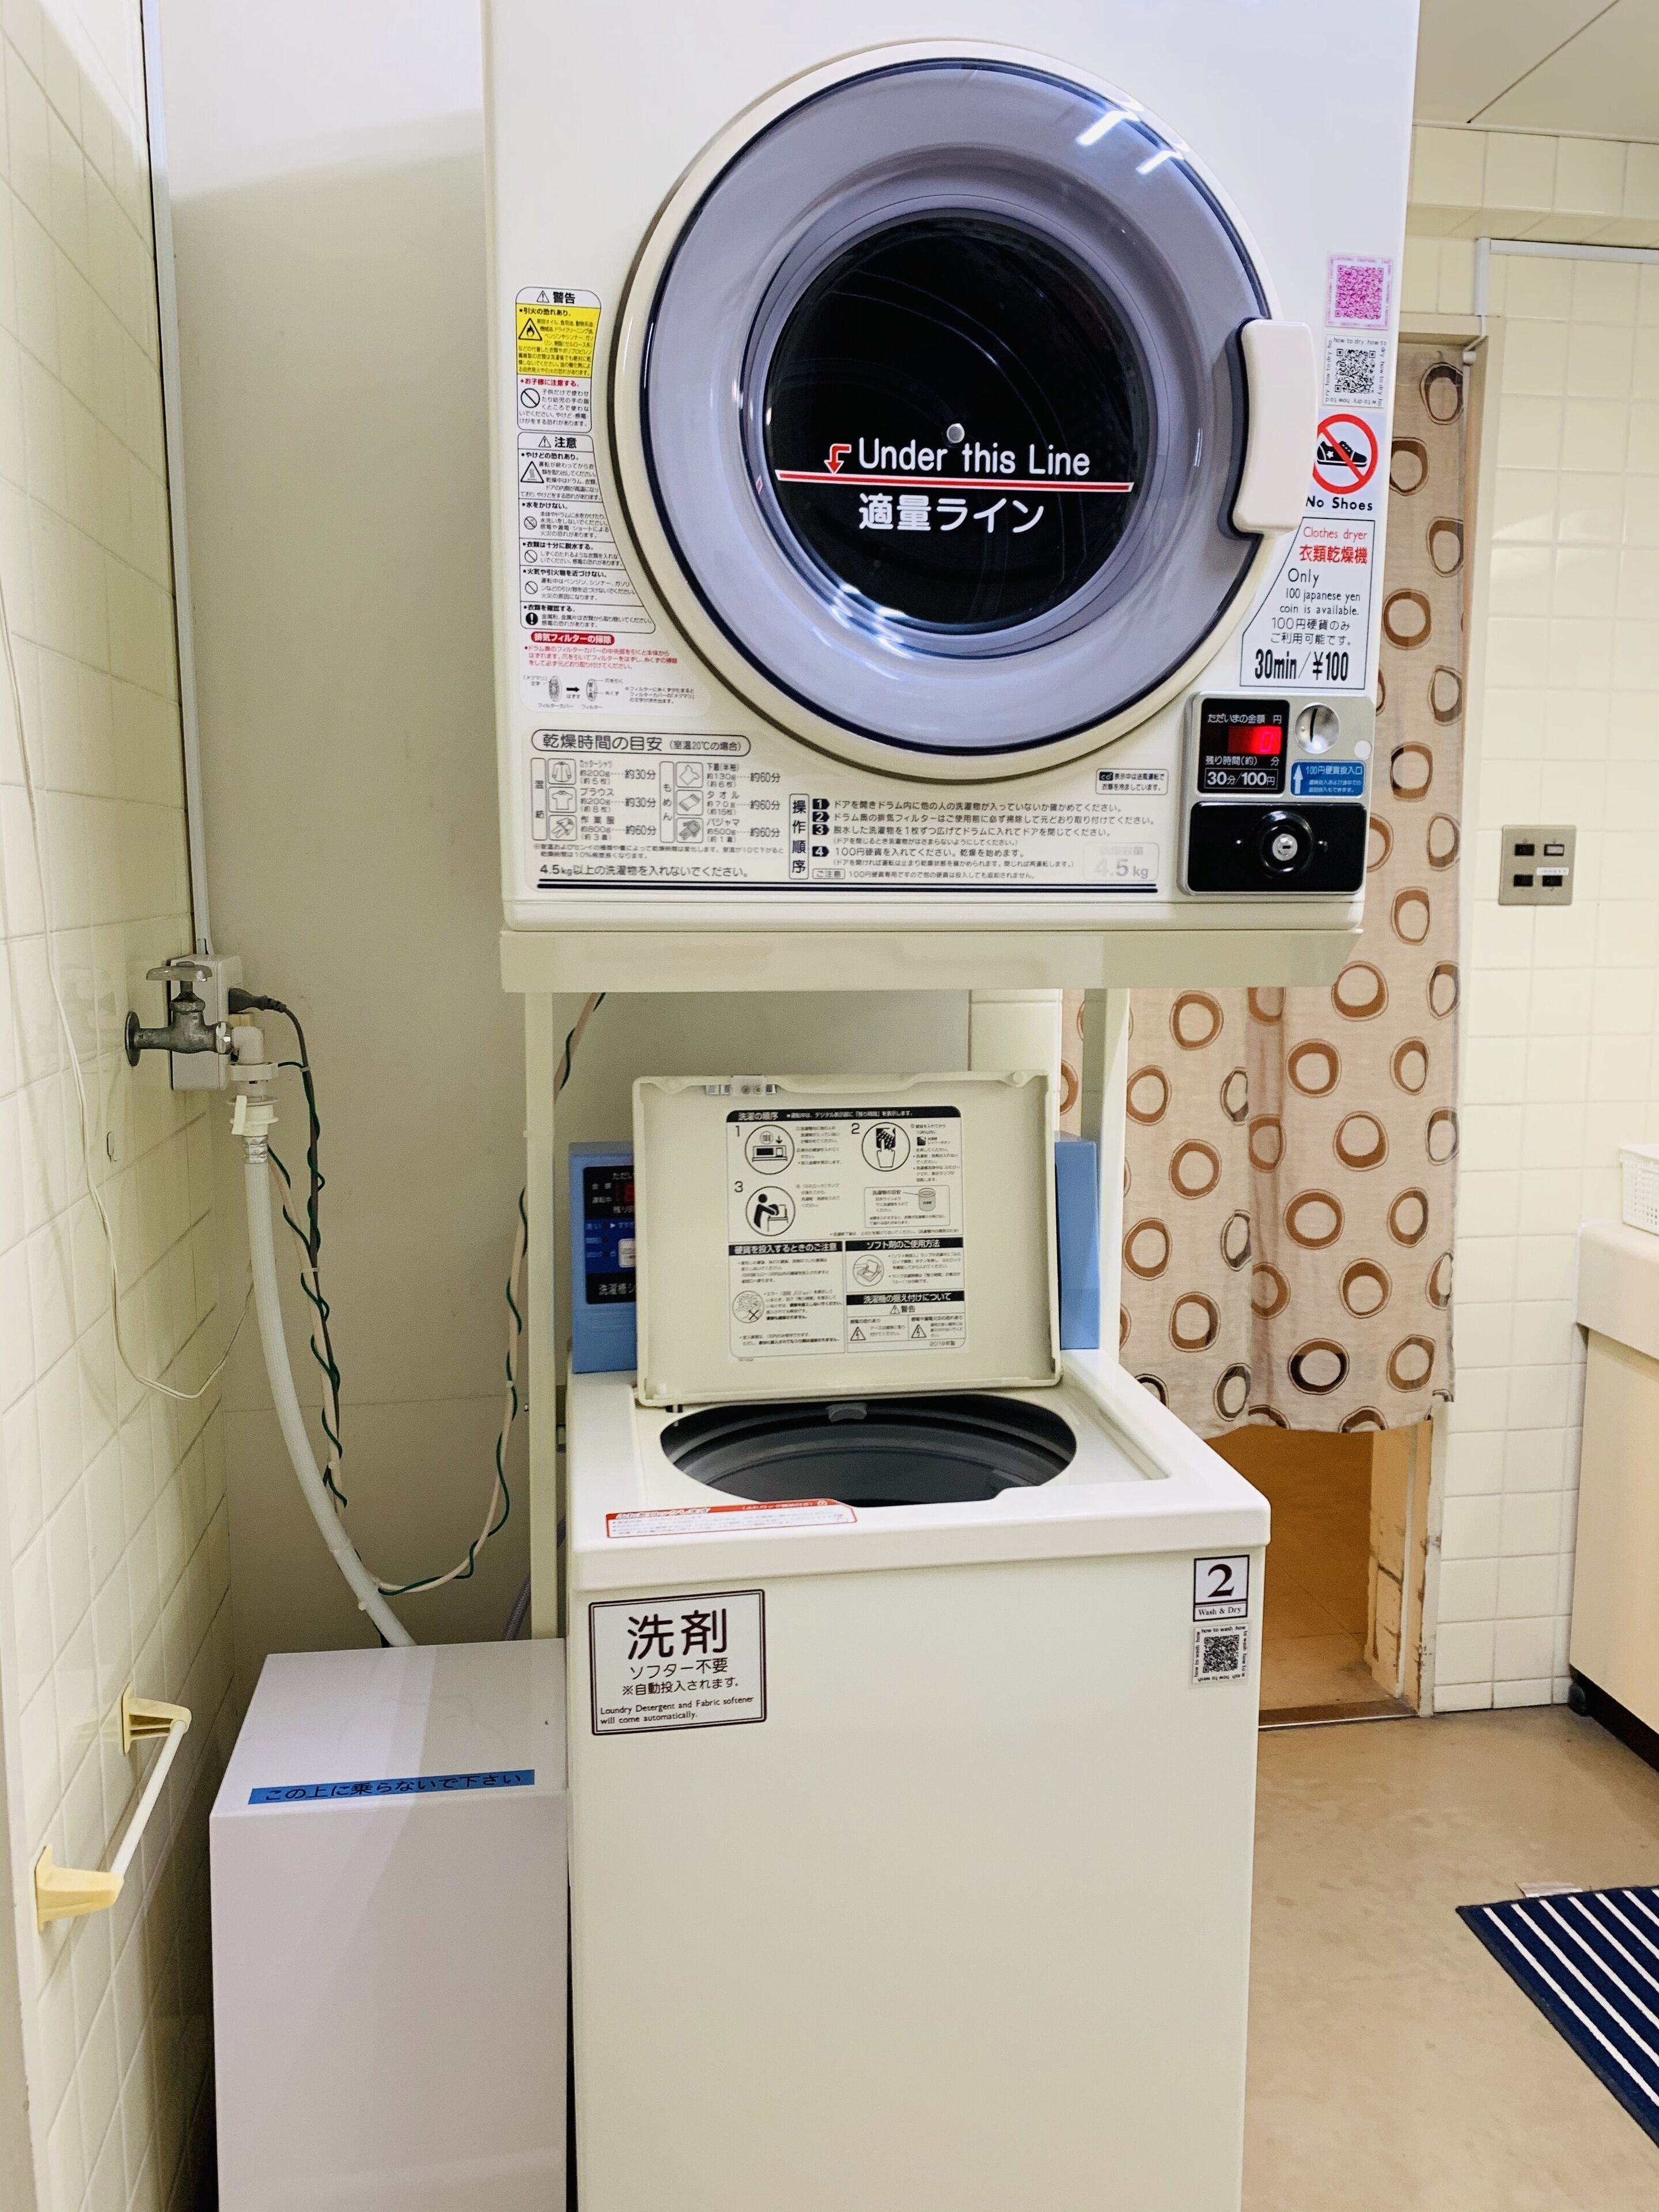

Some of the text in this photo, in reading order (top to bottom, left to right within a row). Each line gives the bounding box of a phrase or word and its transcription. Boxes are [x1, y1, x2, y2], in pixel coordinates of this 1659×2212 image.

[553, 291, 575, 304] 警告
[524, 308, 571, 317] 引火の恐れあり。
[525, 378, 579, 387] お子様に注意する。
[555, 436, 577, 449] 注意
[525, 452, 579, 461] やけどの恐れあり。
[858, 437, 1090, 476] Under this Line
[526, 502, 569, 510] 水をかけない。
[1305, 495, 1373, 511] No Shoes
[858, 493, 1045, 533] 適量ライン
[1303, 527, 1368, 543] Clothes dryer
[527, 541, 594, 550] 衣類は十分に脱水する。
[1300, 544, 1368, 565] 衣類乾燥機
[1288, 567, 1320, 589] Only
[1286, 588, 1361, 604] 100 japanese yen
[528, 604, 575, 613] 衣類を確認する。
[1279, 604, 1359, 616] coin is available.
[1271, 617, 1351, 631] 100円硬貨のみ
[534, 632, 612, 645] 排気フィルターの掃除
[1271, 632, 1351, 646] ご利用可能です。
[1207, 714, 1282, 724] ただいまの金額 円
[543, 733, 662, 751] 乾燥時間の目安
[1259, 731, 1274, 753] 0
[1205, 756, 1280, 766] 残り時間(約) 分
[625, 770, 656, 781] 約30分
[1305, 765, 1363, 775] 100円硬貨投入口
[750, 772, 781, 783] 約60分
[1207, 771, 1276, 786] 30分/100円
[580, 788, 615, 797] ブラウス
[707, 791, 740, 800] タオル
[625, 798, 656, 808] 約30分
[662, 783, 673, 821] もめん
[750, 800, 781, 810] 約60分
[816, 799, 823, 809] 1
[816, 812, 824, 822] 2
[625, 825, 656, 836] 約60分
[750, 827, 781, 838] 約60分
[816, 825, 824, 835] 3
[815, 846, 824, 856] 4
[540, 864, 749, 878] 4.5kg以上の洗濯物を入れないでください。
[1132, 865, 1149, 879] kg
[735, 1125, 740, 1137] 1
[851, 1123, 860, 1135] 2
[734, 1180, 743, 1193] 3
[1207, 1563, 1234, 1599] 2
[1198, 1607, 1217, 1616] Wash
[1228, 1606, 1243, 1615] Dry
[627, 1608, 728, 1661] 洗剤
[630, 1657, 729, 1680] ソフター不要
[622, 1676, 739, 1696] ※自動投入されます。
[635, 1702, 676, 1714] Detergent
[678, 1700, 692, 1710] and
[696, 1698, 720, 1707] Fabric
[724, 1695, 755, 1706] softener
[600, 1711, 698, 1725] will come automatically.
[264, 1774, 522, 1801] この上に乗らないで下さい
